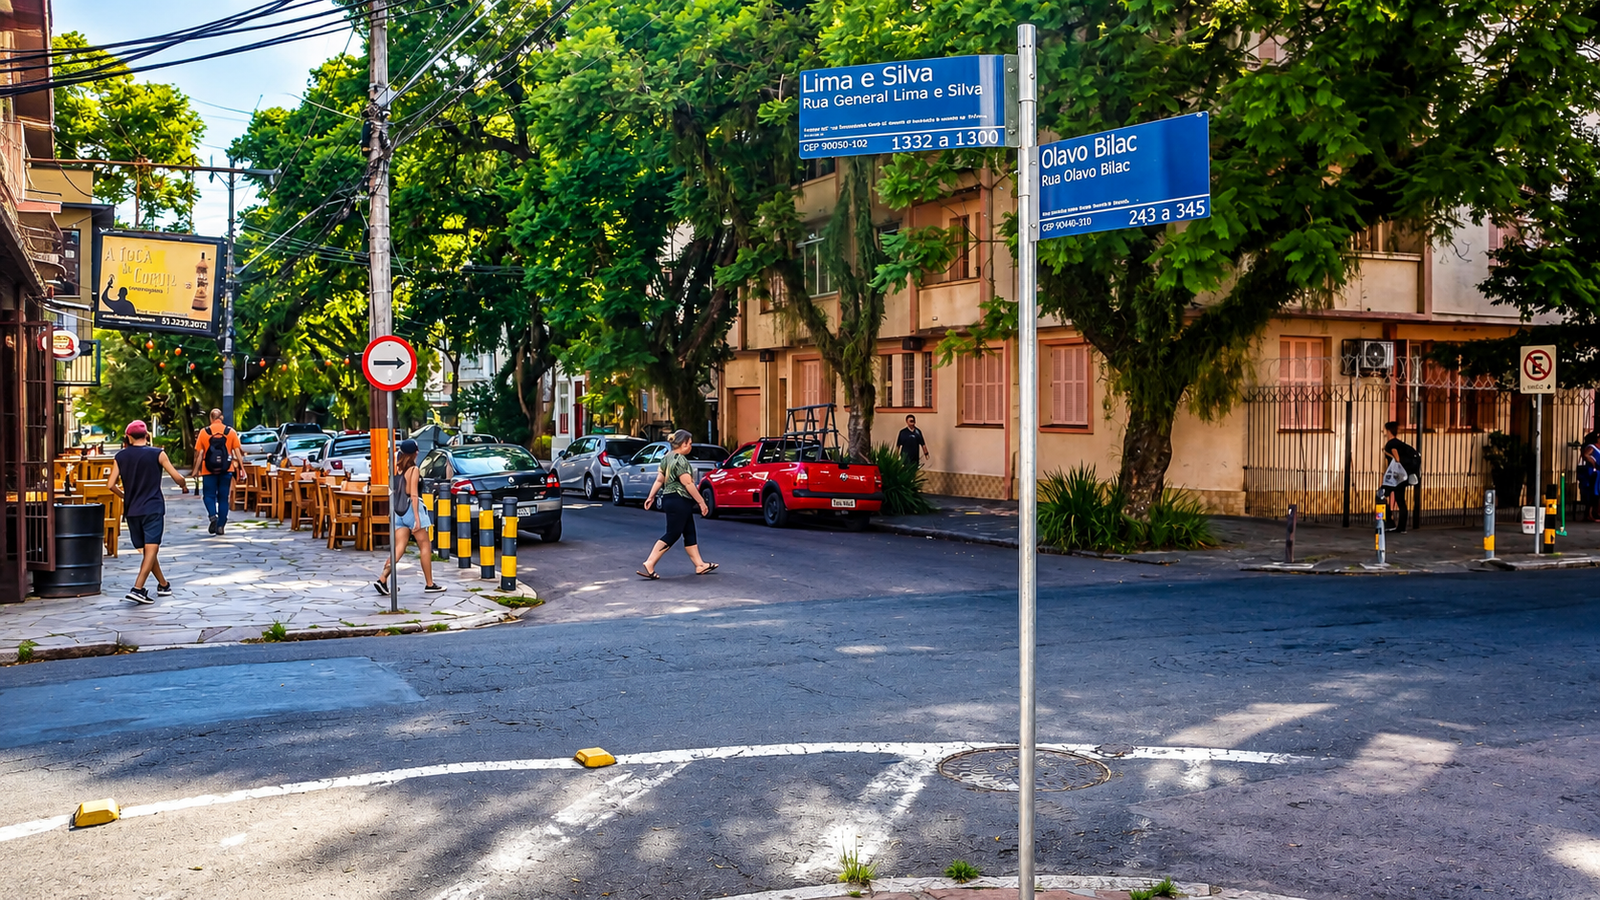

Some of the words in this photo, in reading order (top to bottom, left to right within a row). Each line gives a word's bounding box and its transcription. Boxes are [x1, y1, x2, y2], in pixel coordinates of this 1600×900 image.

[803, 73, 853, 94] Lima
[860, 71, 875, 88] e
[882, 64, 933, 86] Silva
[803, 97, 829, 110] Rua
[833, 89, 888, 107] General
[893, 88, 928, 101] Lima
[933, 87, 943, 98] e
[947, 83, 983, 97] Silva
[803, 143, 820, 152] CEP
[821, 139, 868, 151] 90050-102
[892, 133, 933, 150] 1332
[938, 135, 949, 147] a
[955, 129, 999, 146] 1300
[1041, 146, 1088, 169] Olavo
[1094, 133, 1137, 158] Bilac
[1041, 174, 1061, 187] Rua
[1063, 167, 1097, 182] Olavo
[1100, 160, 1131, 176] Bilac
[1041, 222, 1055, 232] CEP
[1055, 217, 1092, 230] 90440-310
[1128, 207, 1157, 225] 243
[1161, 208, 1170, 221] a
[1176, 199, 1206, 219] 345
[105, 247, 116, 262] A
